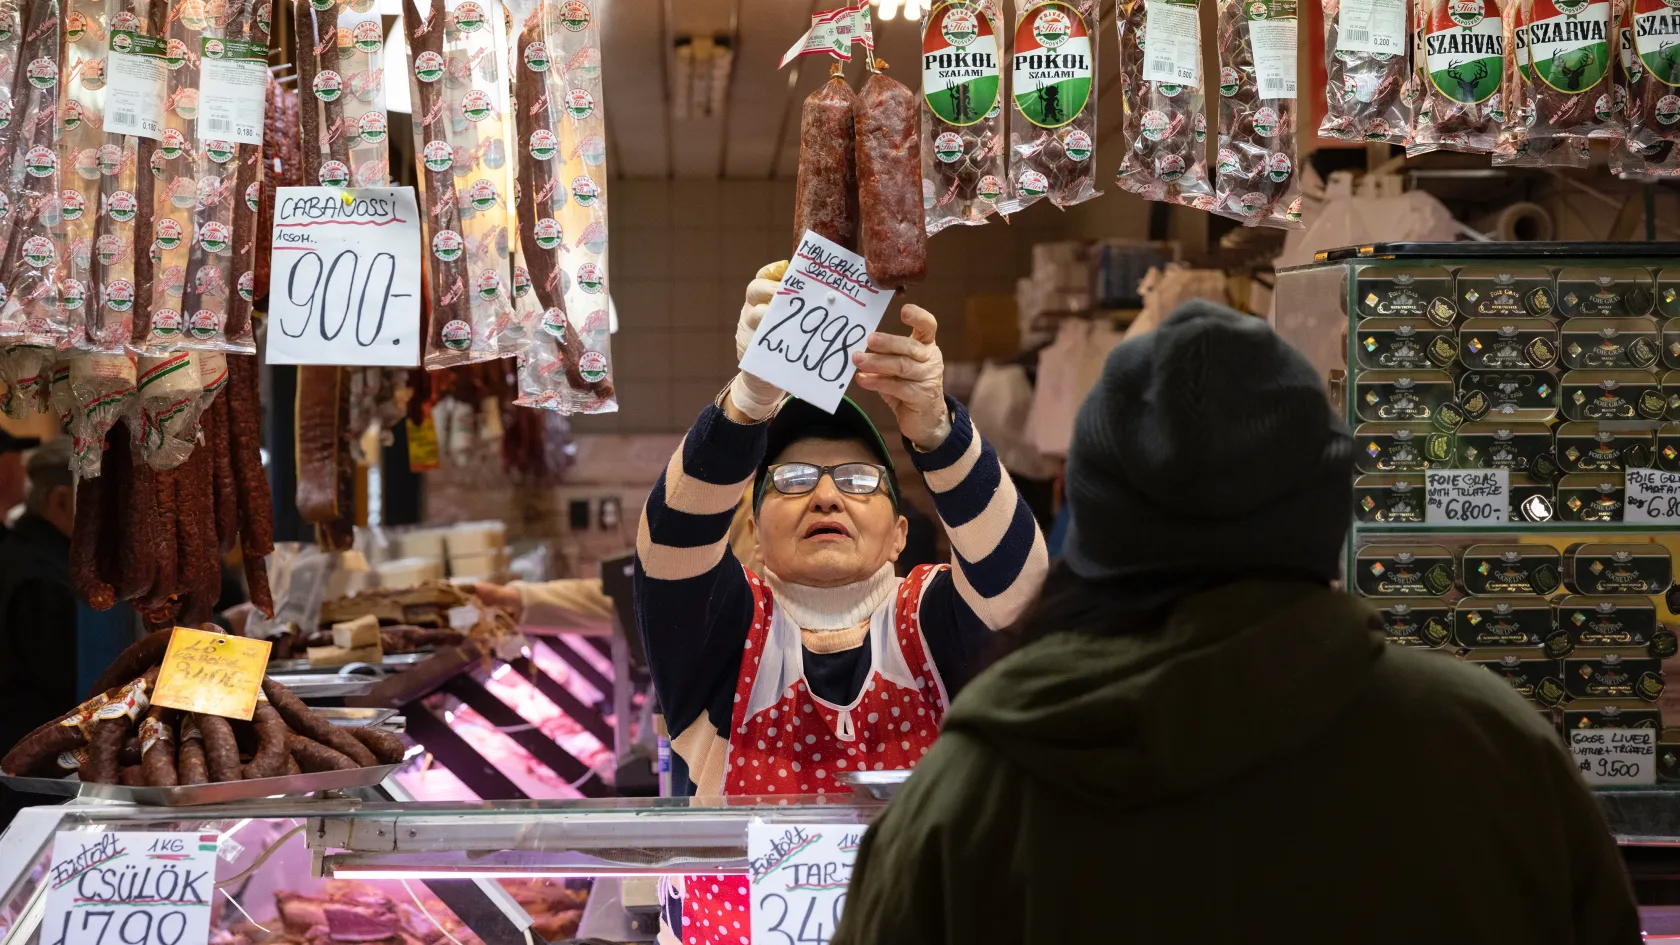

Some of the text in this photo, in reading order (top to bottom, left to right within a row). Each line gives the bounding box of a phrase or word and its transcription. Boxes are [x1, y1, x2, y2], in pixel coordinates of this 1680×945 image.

[1458, 2, 1476, 12] Hús
[1557, 2, 1586, 12] KAPOSVÁR
[1039, 12, 1066, 20] PRIVÁT
[1454, 16, 1480, 26] KAPOSVÁR
[949, 21, 970, 31] Hús
[1042, 22, 1062, 32] Hús
[1039, 36, 1066, 47] KAPOSVÁR
[1374, 38, 1390, 46] 0,200
[1427, 34, 1503, 56] SZARVAS
[925, 52, 996, 70] POKOL
[1014, 54, 1088, 70] POKOL
[1403, 289, 1418, 297] GRAS
[1504, 289, 1519, 297] GRAS
[1589, 295, 1620, 304] FOIE GRAS
[1593, 347, 1625, 355] FOIE GRAS
[1593, 399, 1626, 407] FOIE GRAS
[1588, 450, 1620, 459] FOIE GRAS
[1428, 473, 1498, 486] FOIE GRAS
[1627, 471, 1680, 484] FOIE GR
[1428, 487, 1449, 497] WITH
[1387, 572, 1422, 583] GOOSE LIVER
[1494, 570, 1528, 583] GOOSE LIVER
[1605, 570, 1640, 582] GOOSE LIVER
[1573, 733, 1652, 744] GOOSE LIVER
[78, 864, 208, 904] CSÜLÖK
